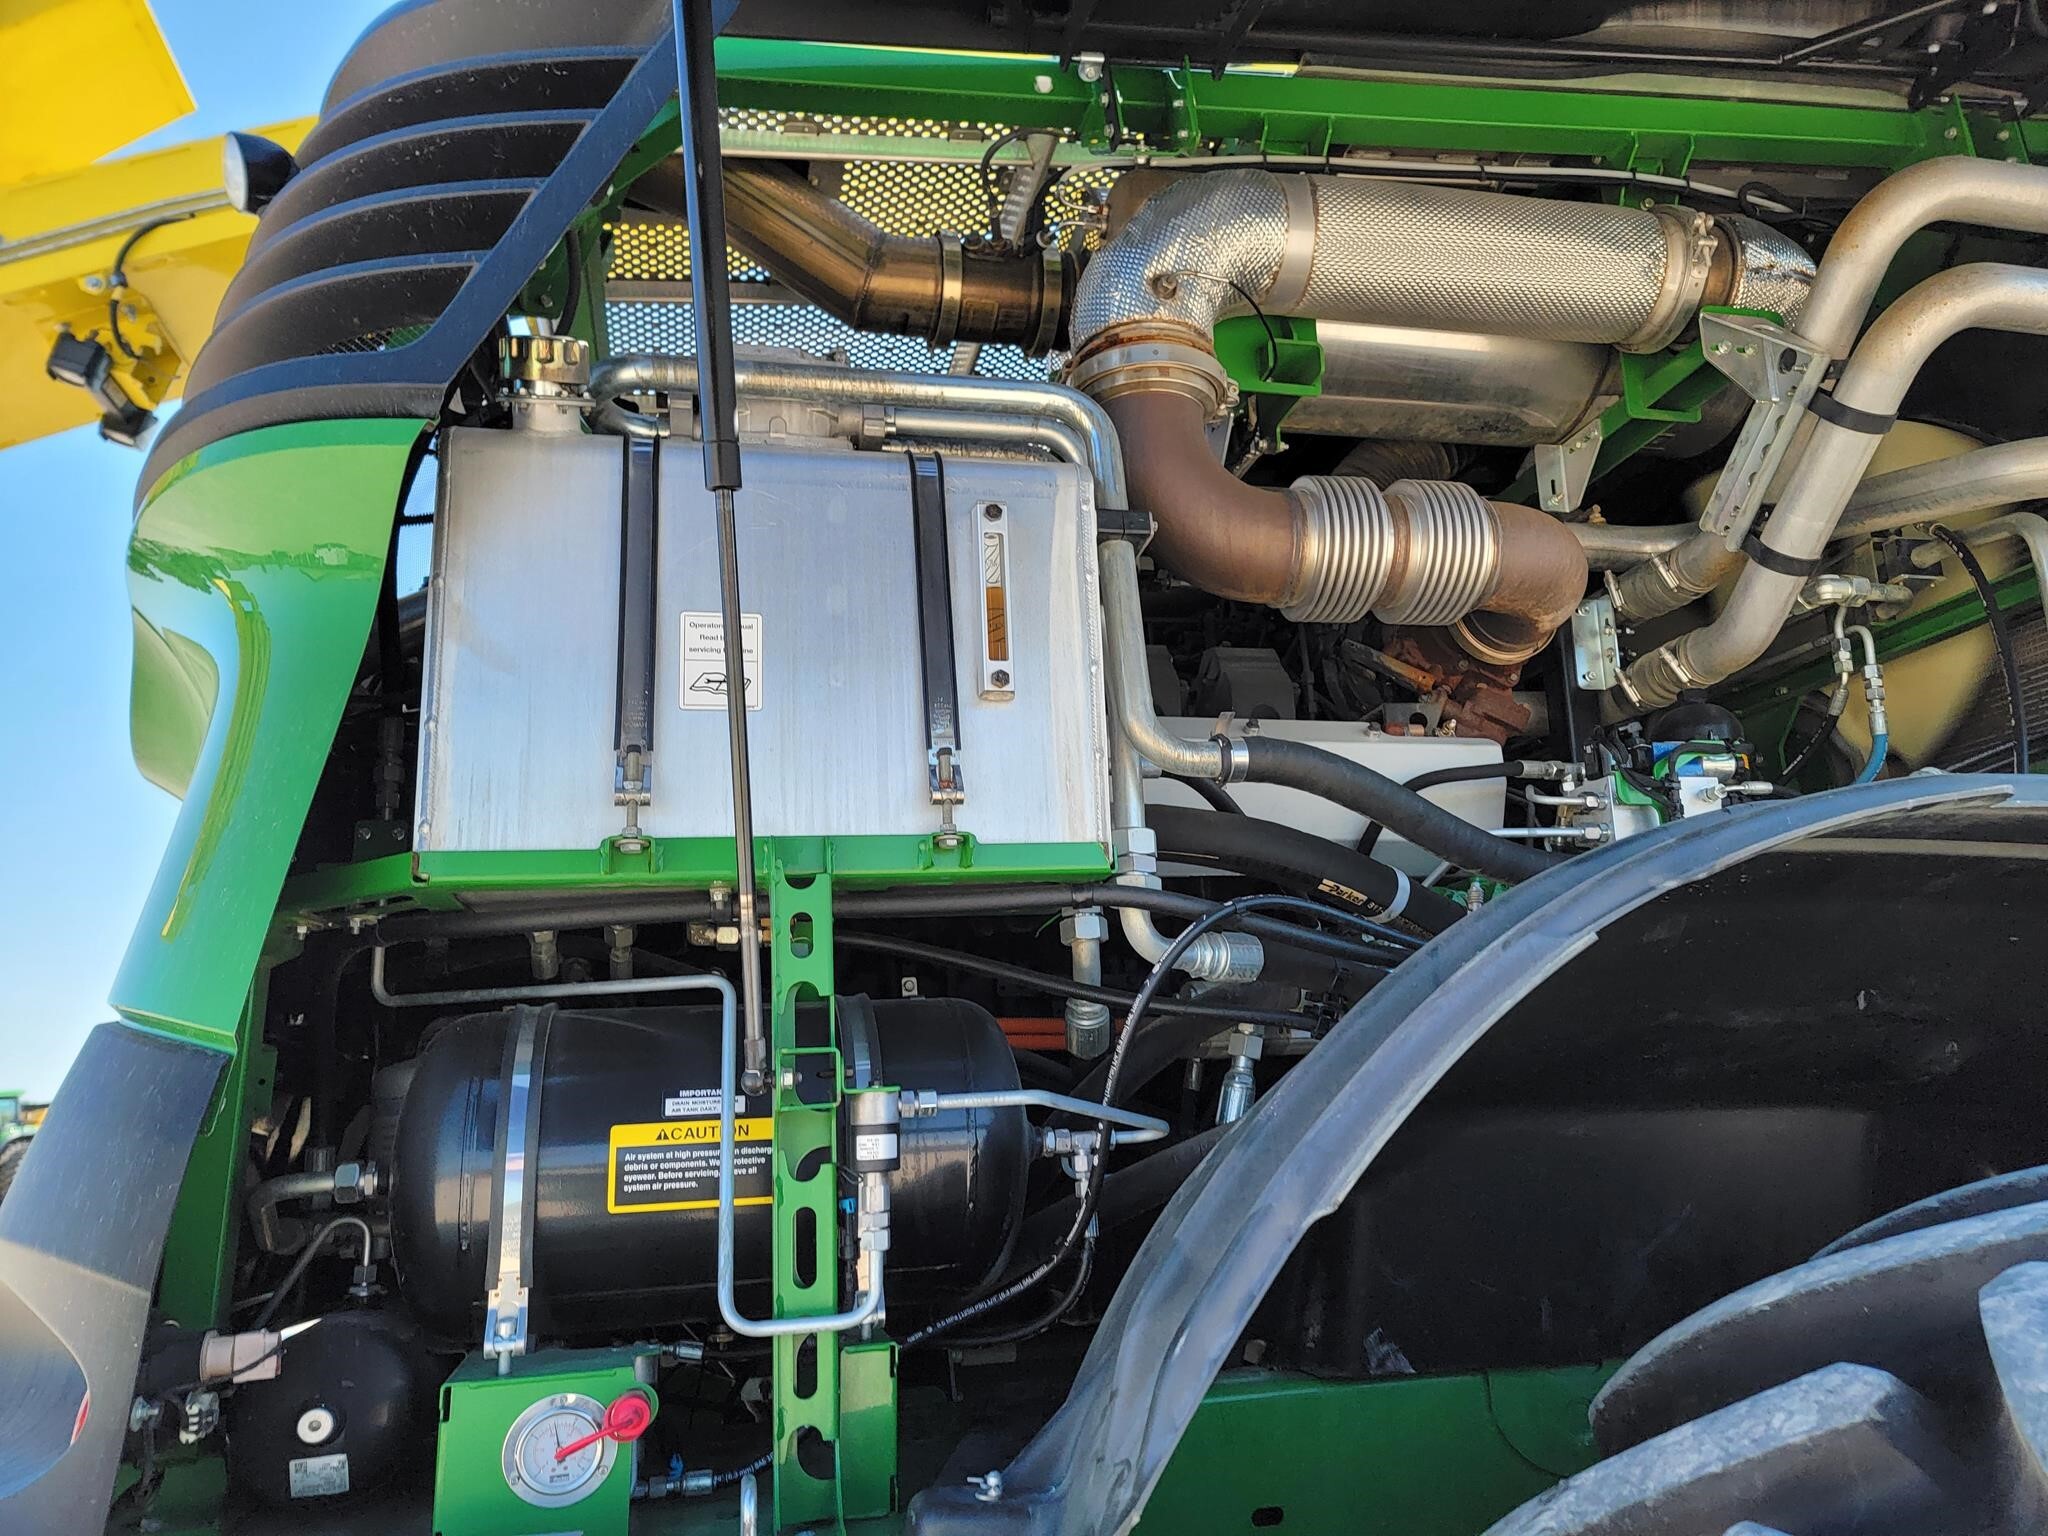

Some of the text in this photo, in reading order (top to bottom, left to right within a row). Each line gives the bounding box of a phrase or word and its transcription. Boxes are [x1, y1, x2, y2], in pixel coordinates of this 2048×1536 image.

[689, 621, 723, 629] Operator
[688, 646, 722, 654] servicing
[1328, 883, 1365, 905] Parker
[680, 1088, 722, 1098] IMPORTAN
[670, 1124, 750, 1140] CAUTN
[624, 1152, 637, 1162] Air
[638, 1150, 664, 1162] system
[666, 1151, 674, 1160] at
[674, 1150, 692, 1160] high
[692, 1148, 720, 1160] pressur
[740, 1146, 773, 1156] discharg
[624, 1162, 648, 1172] debris
[650, 1162, 658, 1170] or
[660, 1160, 708, 1170] components.
[734, 1156, 766, 1166] rotective
[624, 1172, 657, 1183] eyewear.
[658, 1170, 683, 1180] Before
[748, 1166, 758, 1175] all
[624, 1180, 699, 1194] system air pressure.
